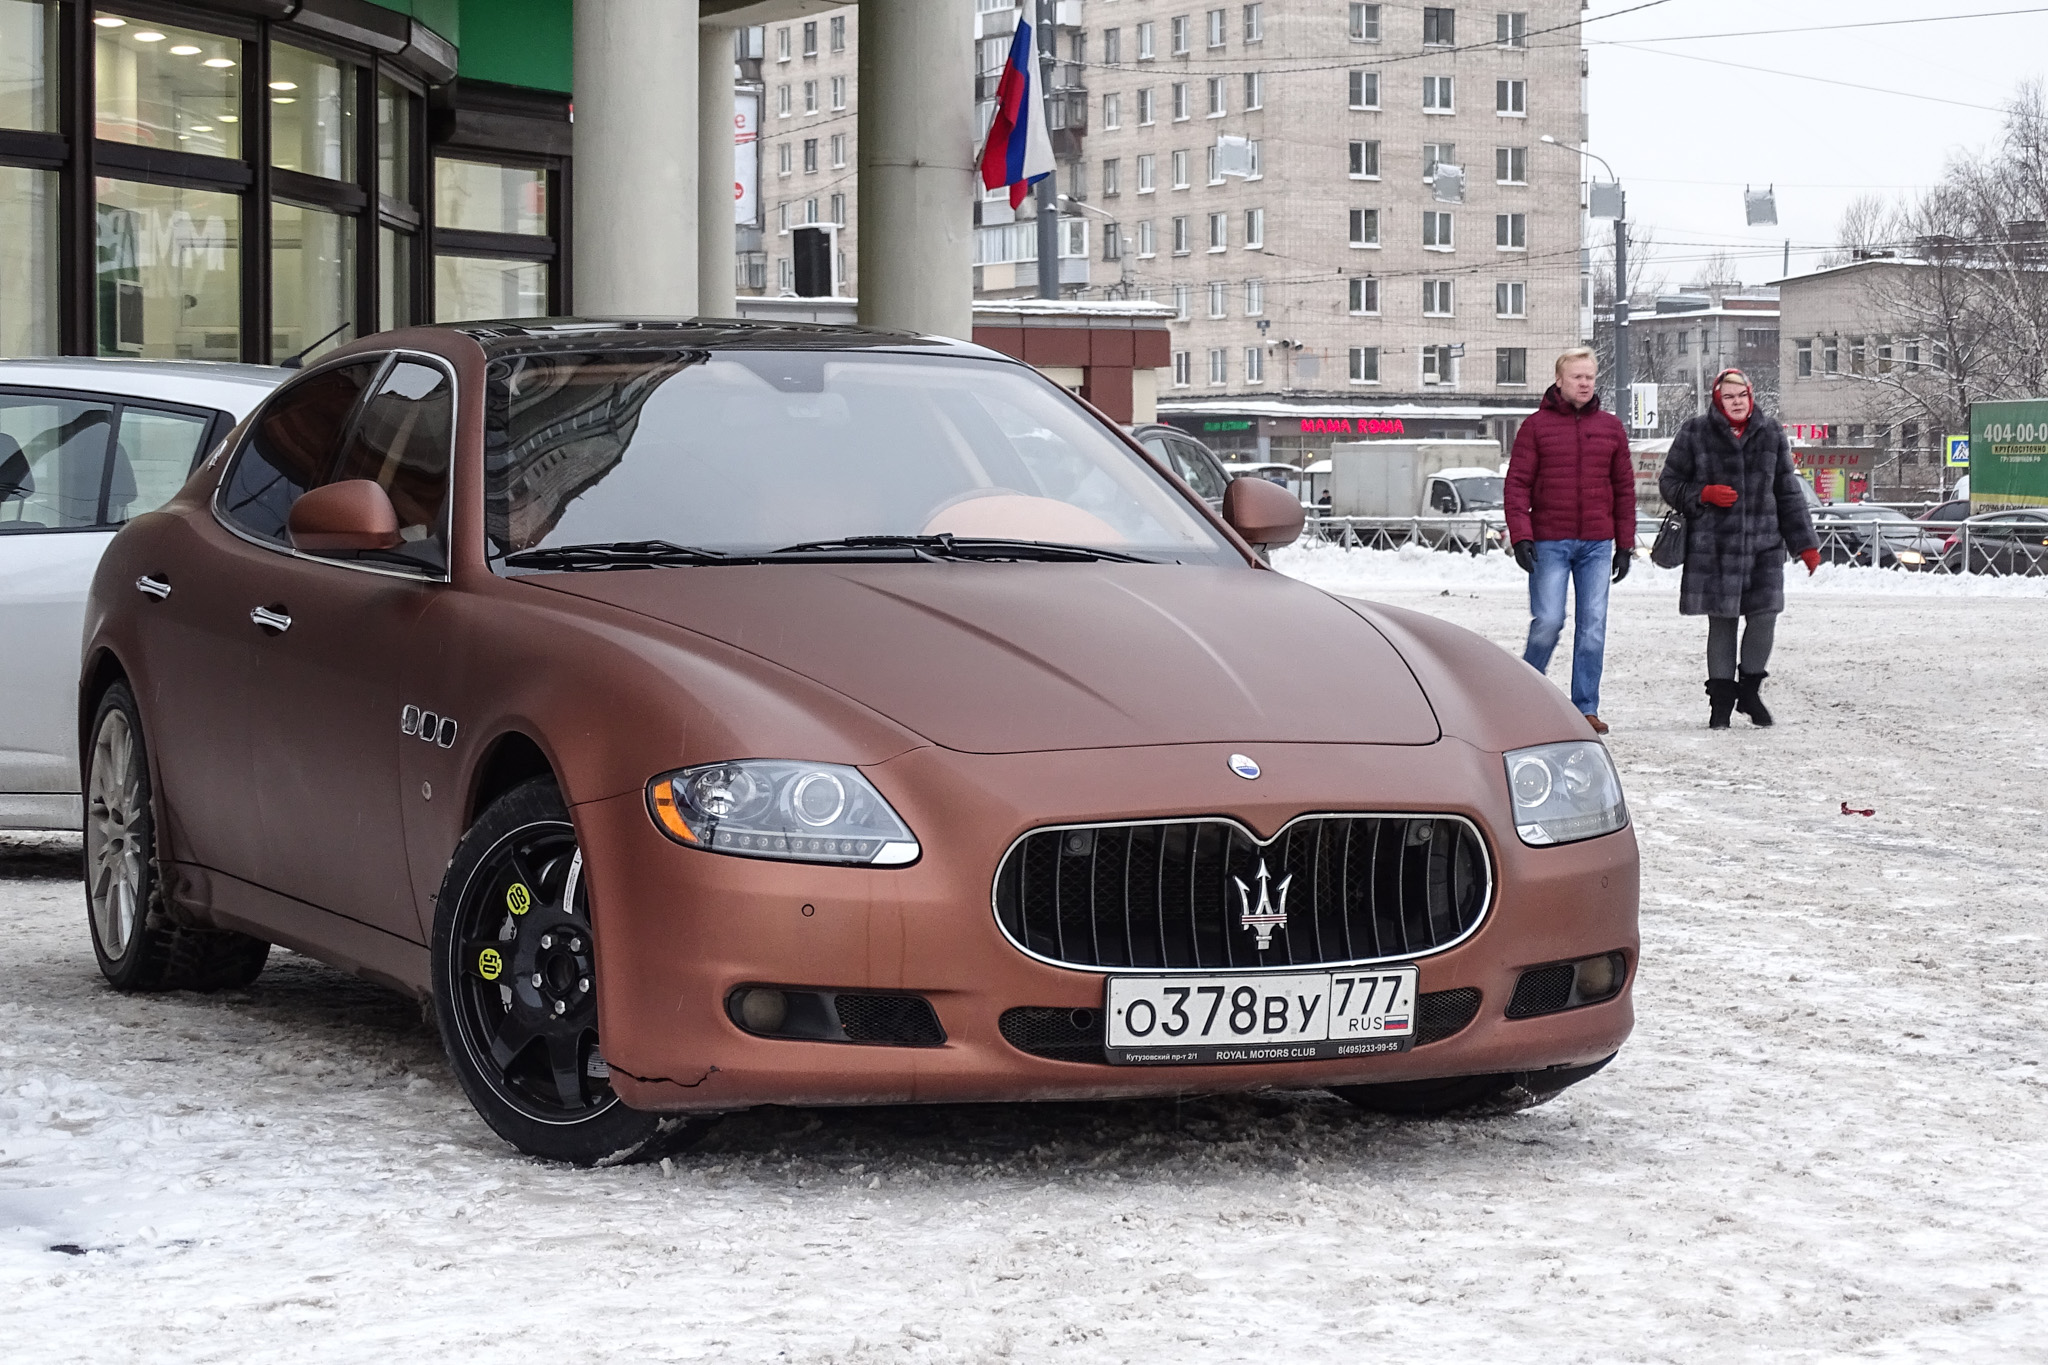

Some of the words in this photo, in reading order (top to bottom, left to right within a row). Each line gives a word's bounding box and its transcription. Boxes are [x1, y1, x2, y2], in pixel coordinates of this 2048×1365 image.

[1301, 418, 1352, 434] MAMA
[1357, 418, 1405, 434] ROMA
[1782, 423, 1829, 440] ТЫ
[1806, 454, 1859, 465] ЦВЕТЫ
[509, 886, 526, 910] 80
[483, 953, 498, 975] 50
[1125, 985, 1322, 1037] О378ВУ
[1335, 975, 1403, 1017] 777
[1349, 1016, 1383, 1032] RUS
[1126, 1052, 1170, 1061] Кутузовский
[1171, 1053, 1187, 1061] пр-т
[1188, 1052, 1198, 1060] 2/1
[1216, 1051, 1248, 1060] ROYAL
[1250, 1049, 1289, 1060] MOTORS
[1291, 1047, 1316, 1058] CLUB
[1338, 1042, 1398, 1055] 8(495)233-99-55
